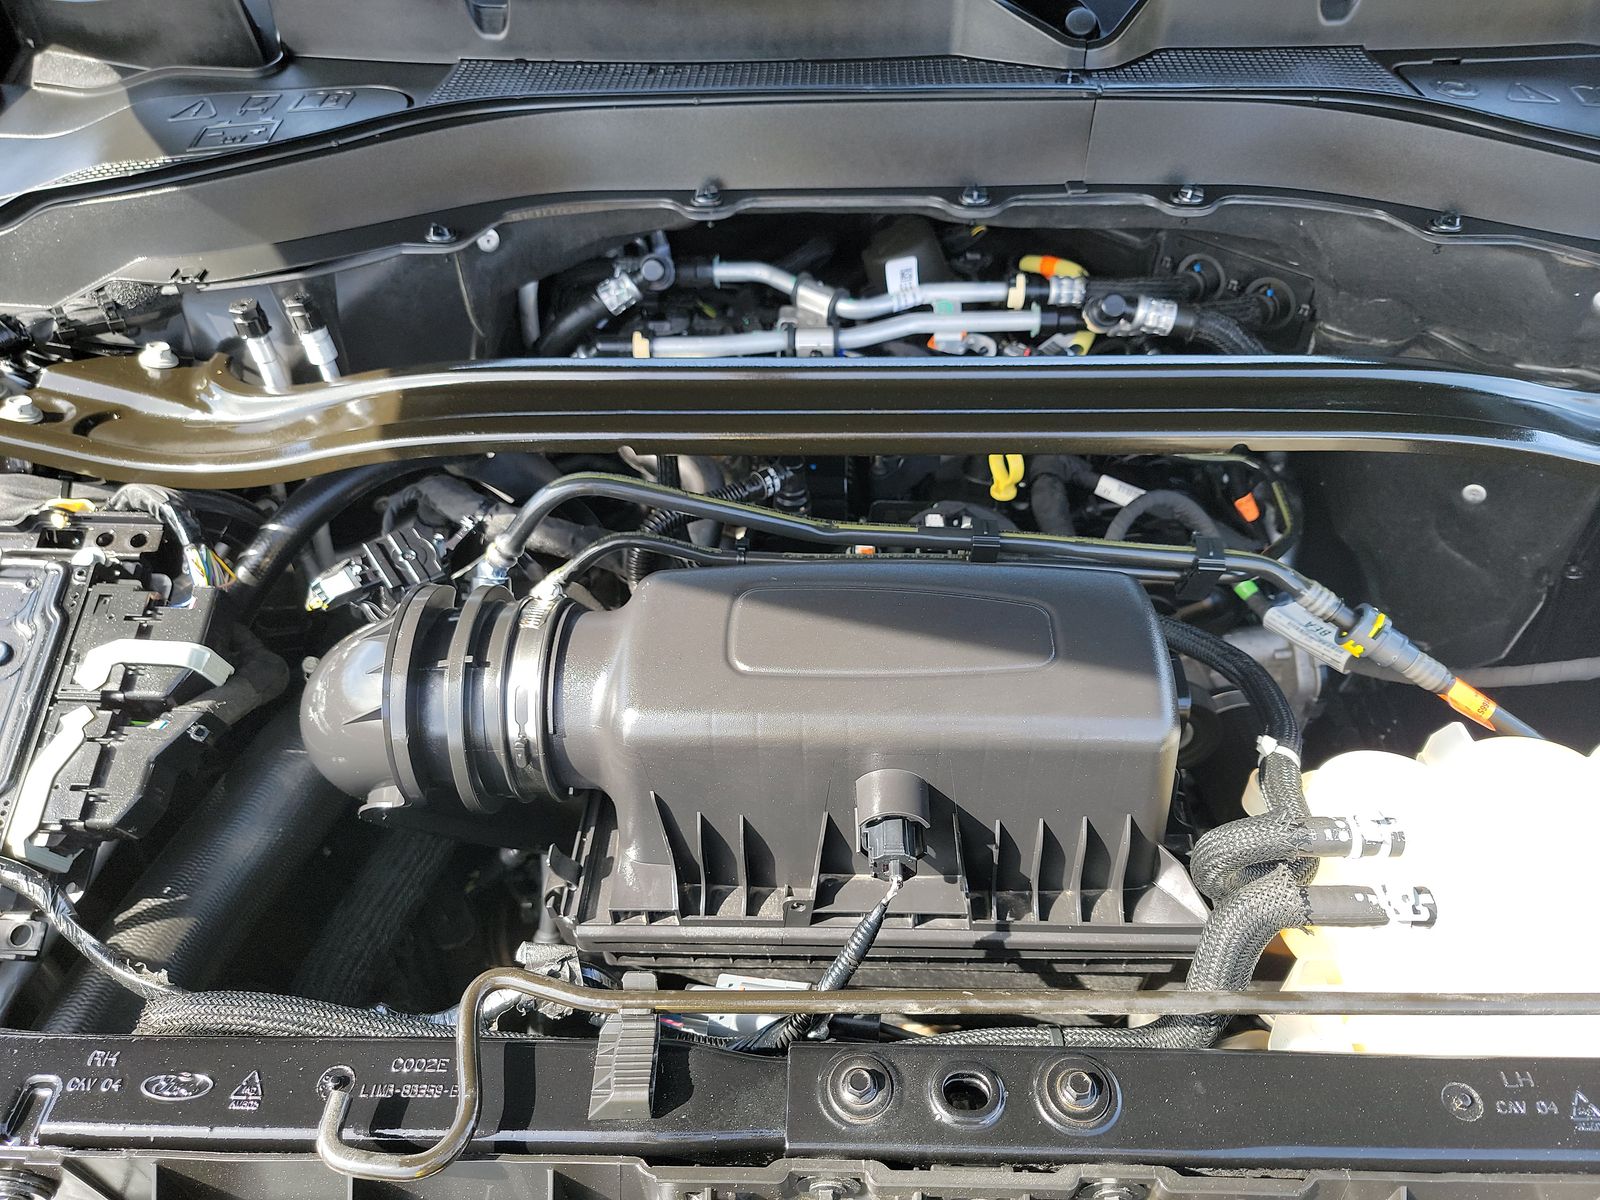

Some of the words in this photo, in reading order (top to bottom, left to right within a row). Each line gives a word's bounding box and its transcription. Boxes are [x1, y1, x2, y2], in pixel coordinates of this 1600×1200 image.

[87, 1050, 121, 1067] RH
[100, 1078, 123, 1092] 04
[1500, 1071, 1535, 1088] LH
[1496, 1100, 1527, 1115] CAV
[1536, 1100, 1559, 1115] 04
